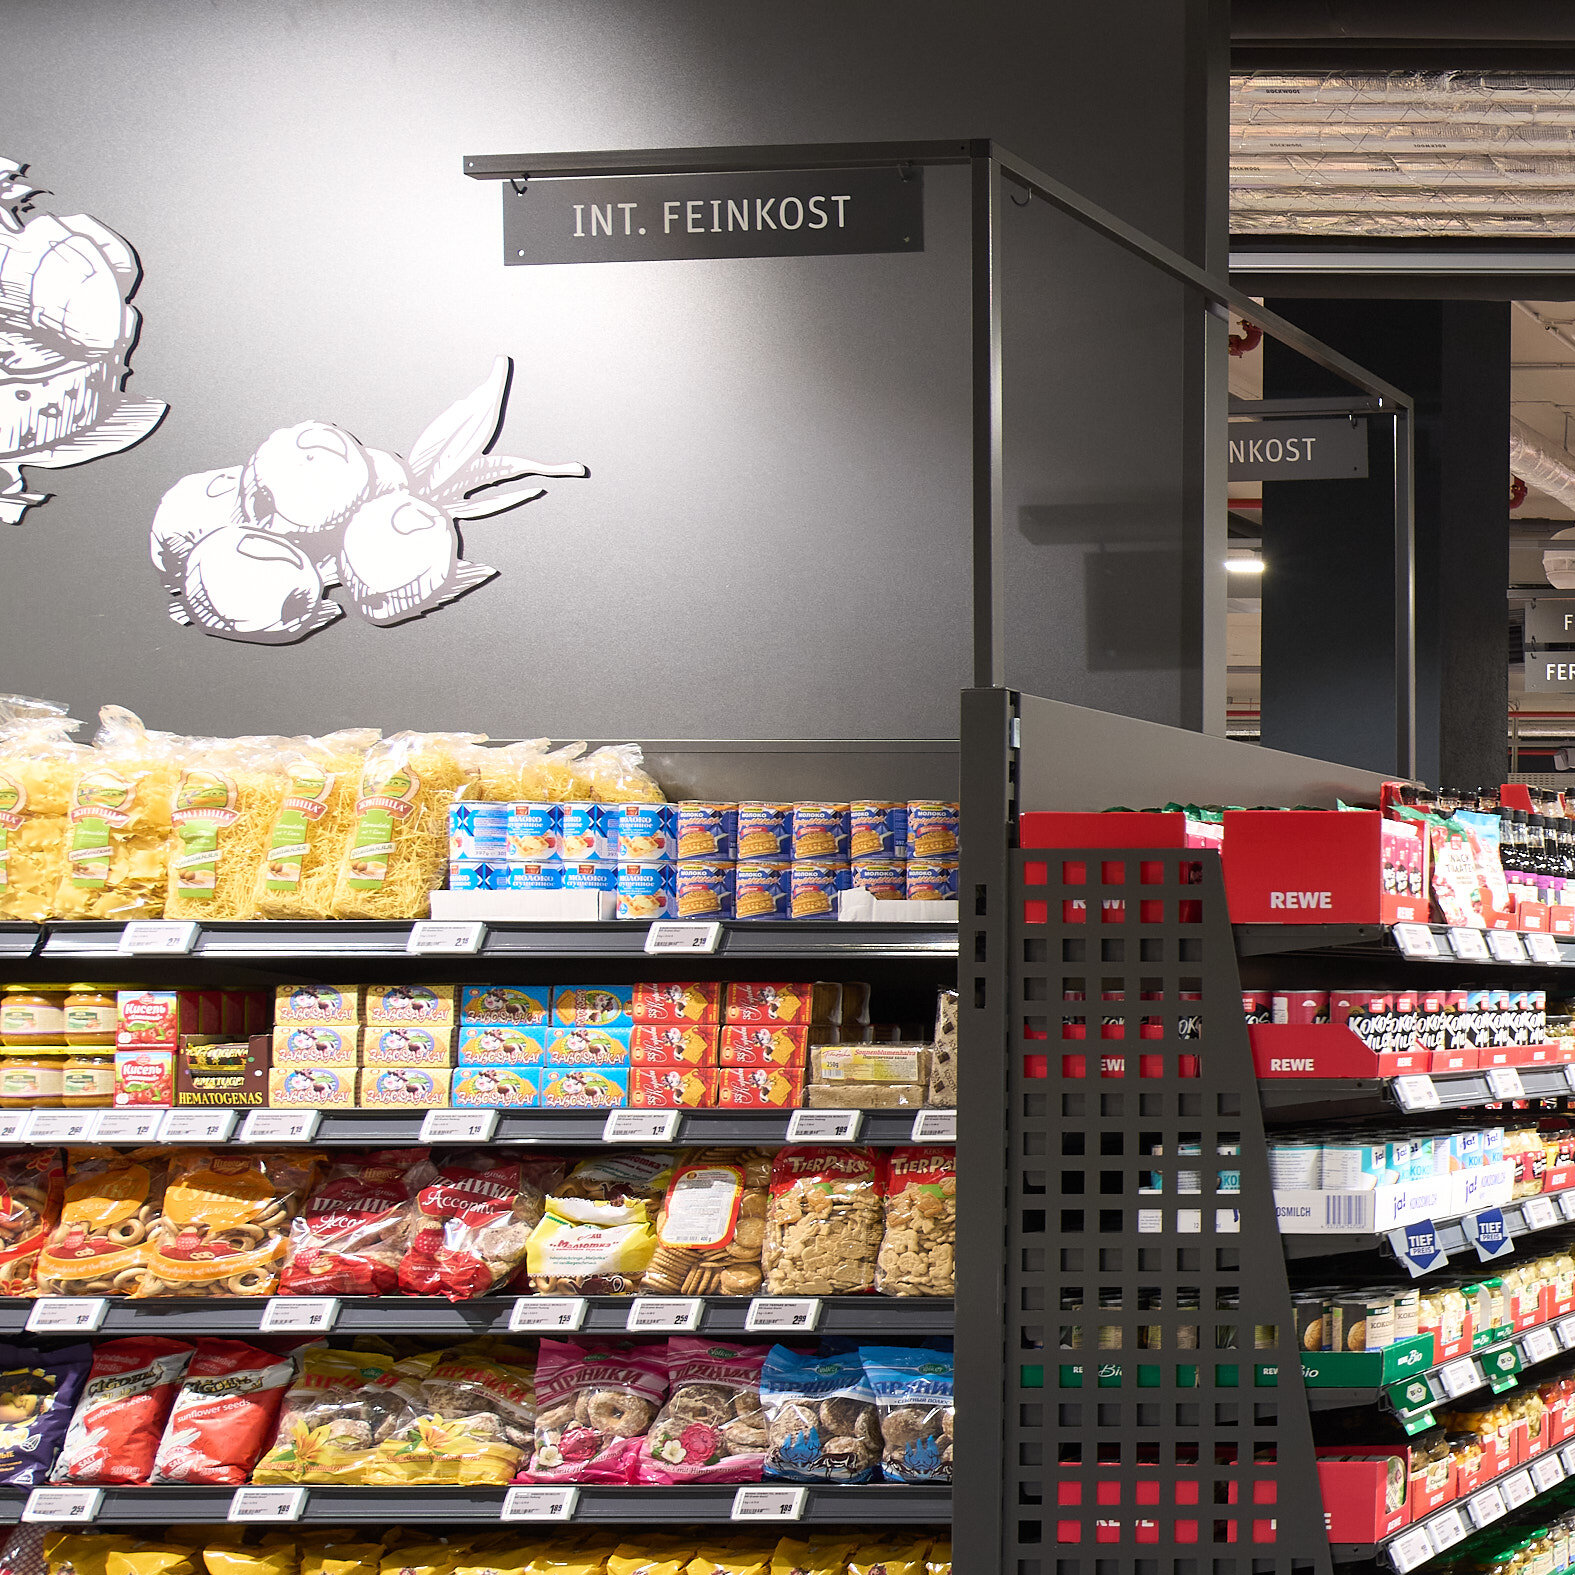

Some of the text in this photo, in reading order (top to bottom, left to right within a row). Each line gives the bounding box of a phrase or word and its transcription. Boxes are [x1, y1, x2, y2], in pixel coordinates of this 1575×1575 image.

[573, 195, 852, 238] INT. FEINKOST
[1270, 891, 1332, 909] REWE
[124, 1003, 166, 1018] Кисель
[123, 1063, 163, 1077] Кисель
[1270, 1058, 1315, 1072] REWE
[179, 1092, 263, 1106] HEMATOGENAS
[1461, 1133, 1478, 1151] ja!
[1392, 1190, 1407, 1220] ja!
[1478, 1222, 1502, 1234] TIEF
[1408, 1234, 1433, 1247] TIEF
[1482, 1233, 1502, 1241] PREIS
[1412, 1246, 1434, 1254] PREIS
[84, 1394, 152, 1425] sunflower seeds
[77, 1455, 96, 1470] SALT
